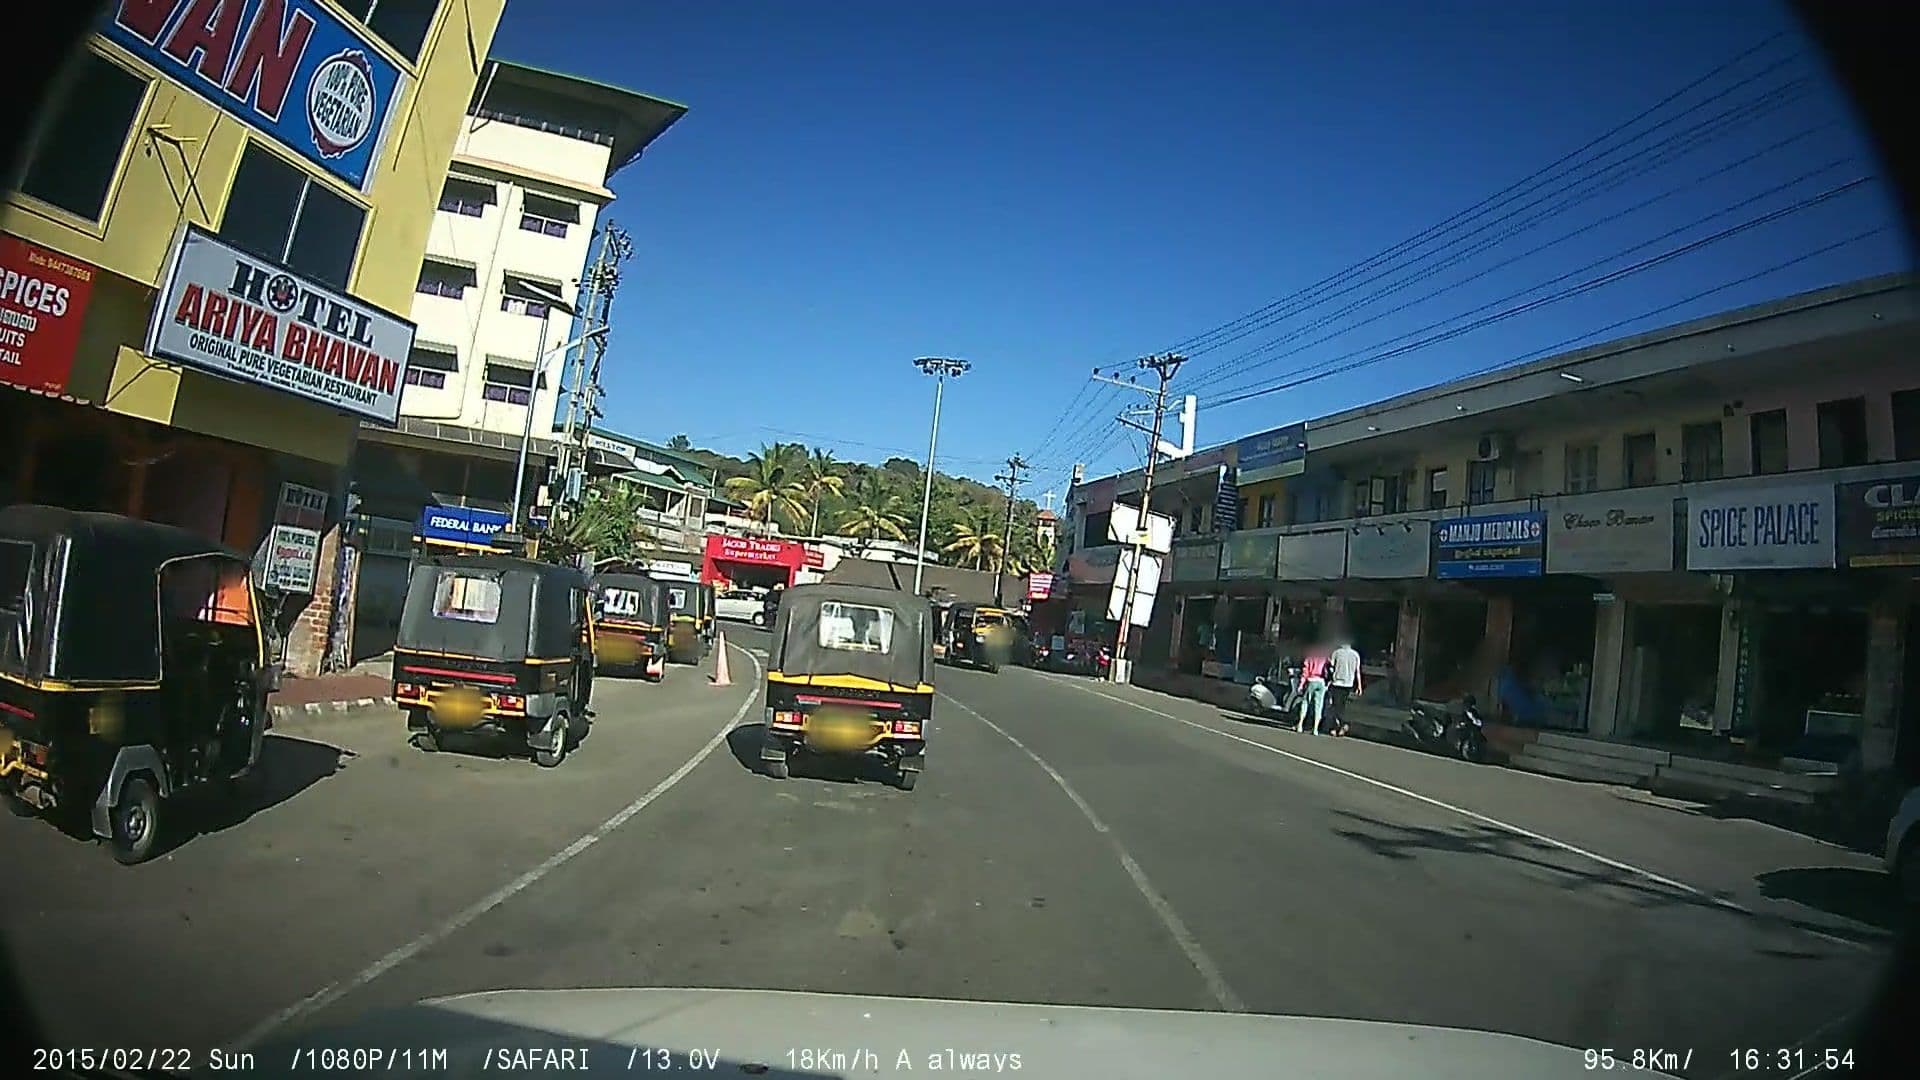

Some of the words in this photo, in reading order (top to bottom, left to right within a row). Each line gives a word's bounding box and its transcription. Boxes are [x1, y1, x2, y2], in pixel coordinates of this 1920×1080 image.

[312, 90, 364, 140] VEGETARIAN
[345, 70, 368, 113] PURE
[174, 282, 279, 356] ARIYA
[282, 321, 400, 395] BHAVAN
[189, 332, 237, 361] ORIGINAL
[236, 347, 267, 372] PURE
[267, 358, 323, 389] VEGETARIAN
[323, 377, 378, 406] RESTAURANT
[430, 515, 470, 531] FEDERAL
[1449, 523, 1481, 543] MANJU
[1483, 518, 1530, 541] MEDICALS
[1699, 507, 1748, 550] SPICE
[1754, 502, 1820, 547] PALACE
